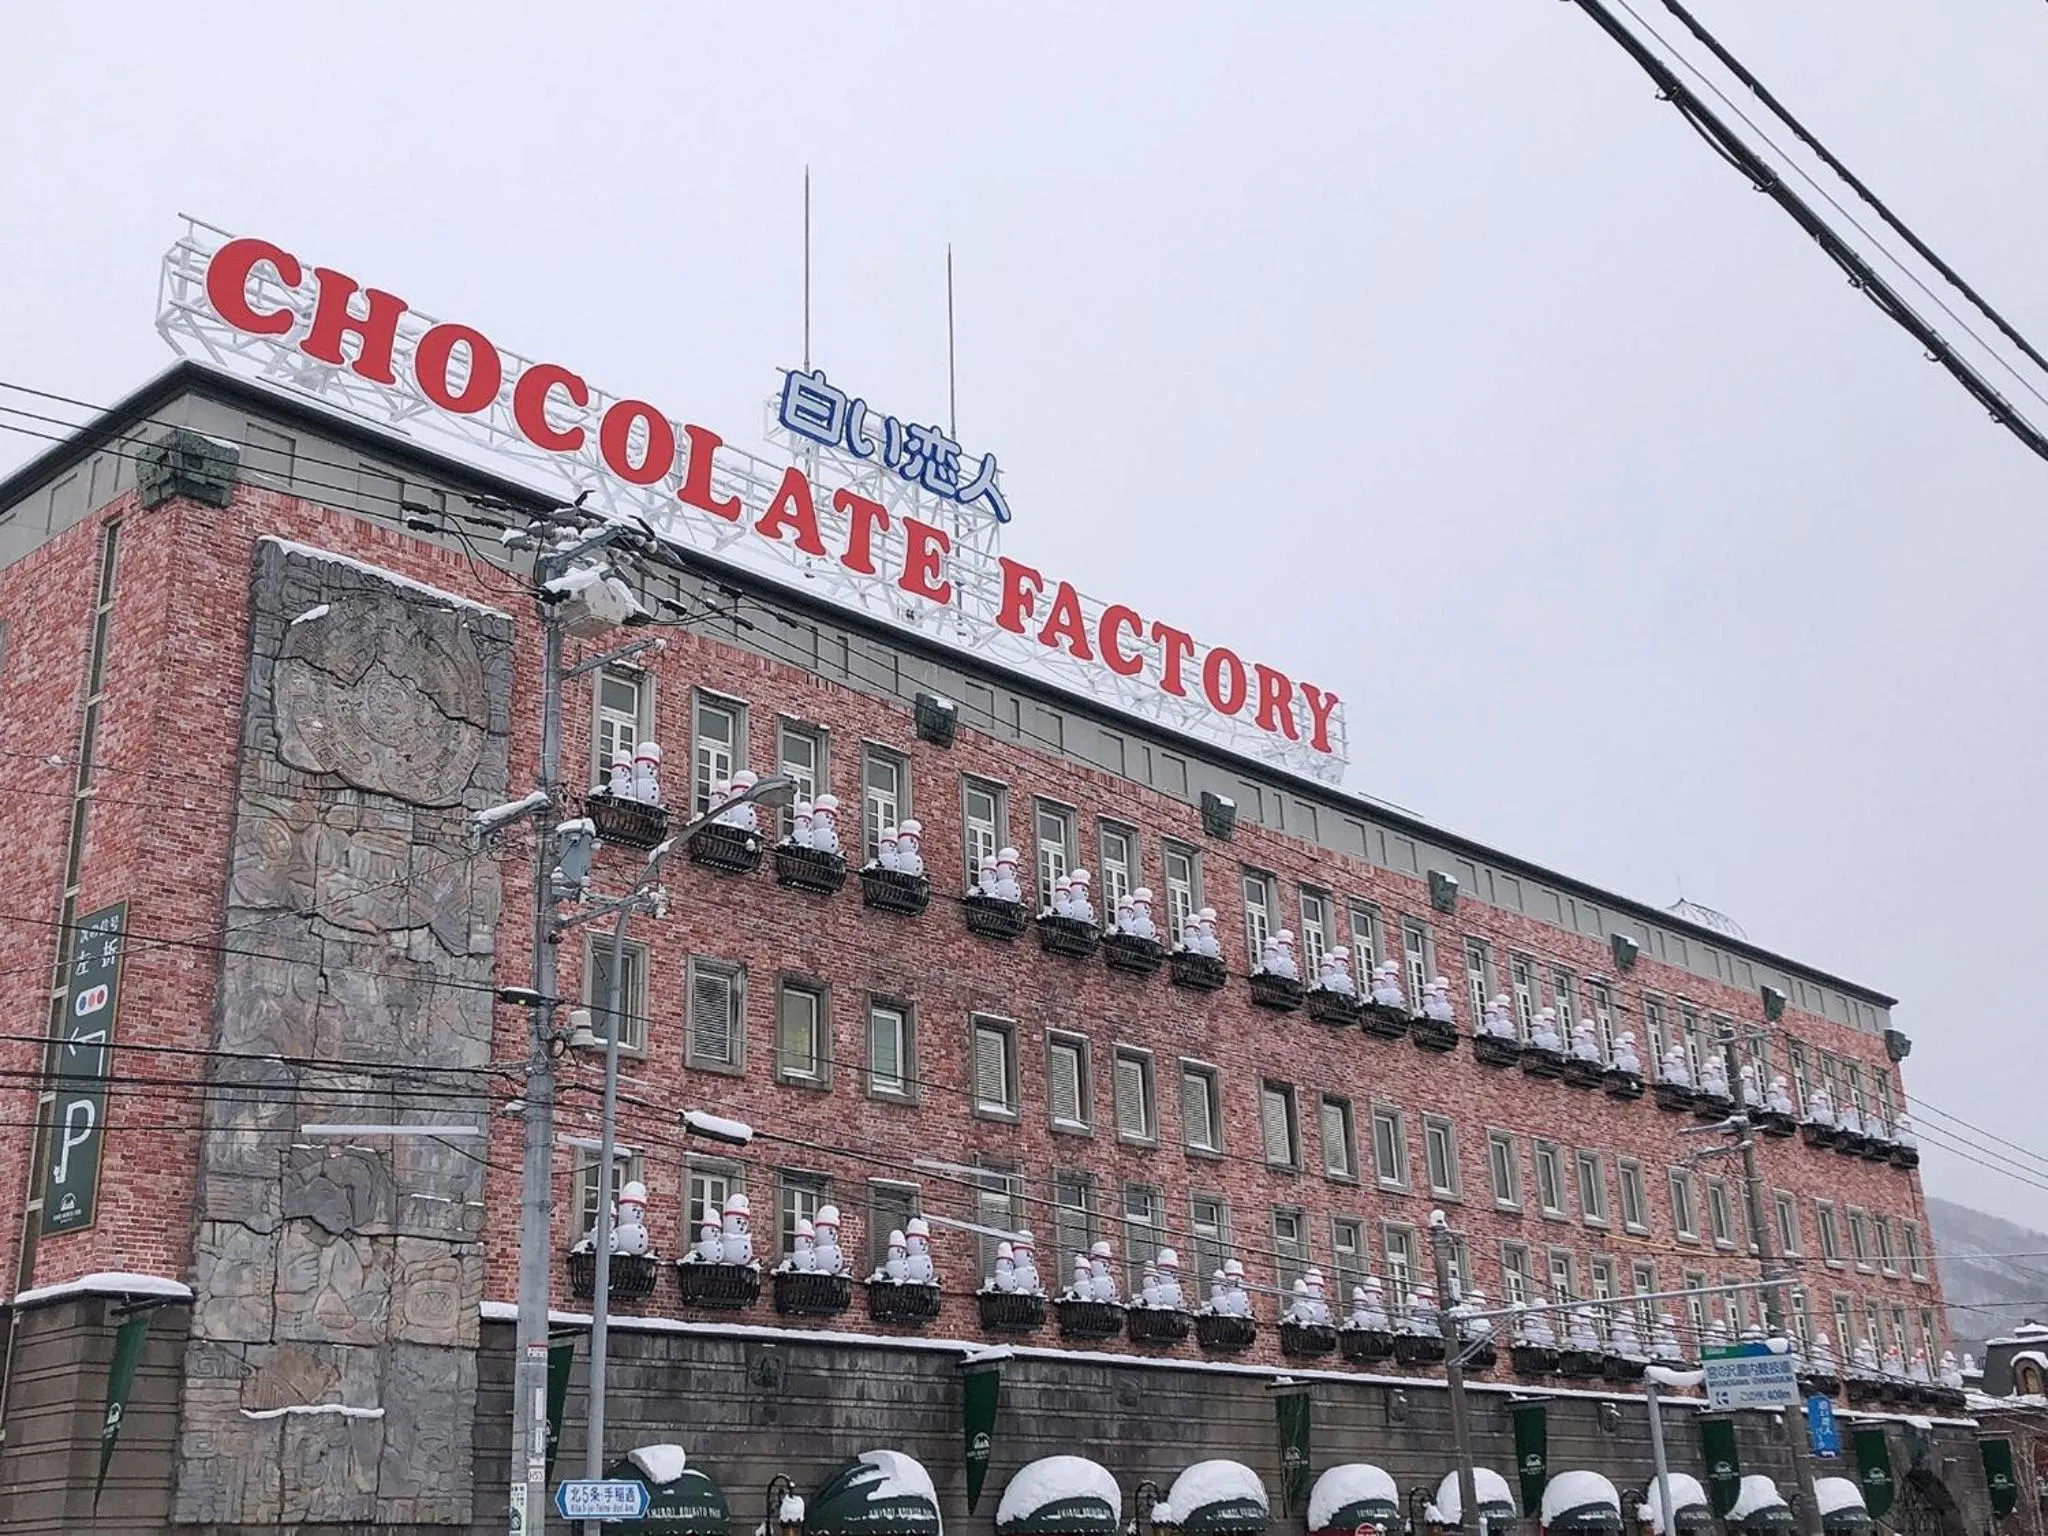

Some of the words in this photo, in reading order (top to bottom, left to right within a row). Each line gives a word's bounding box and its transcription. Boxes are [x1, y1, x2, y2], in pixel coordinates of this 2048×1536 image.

[206, 238, 952, 604] CHOCOLATE
[997, 556, 1339, 754] FACTORY
[779, 369, 1012, 523] 白い恋人
[53, 1099, 95, 1184] P
